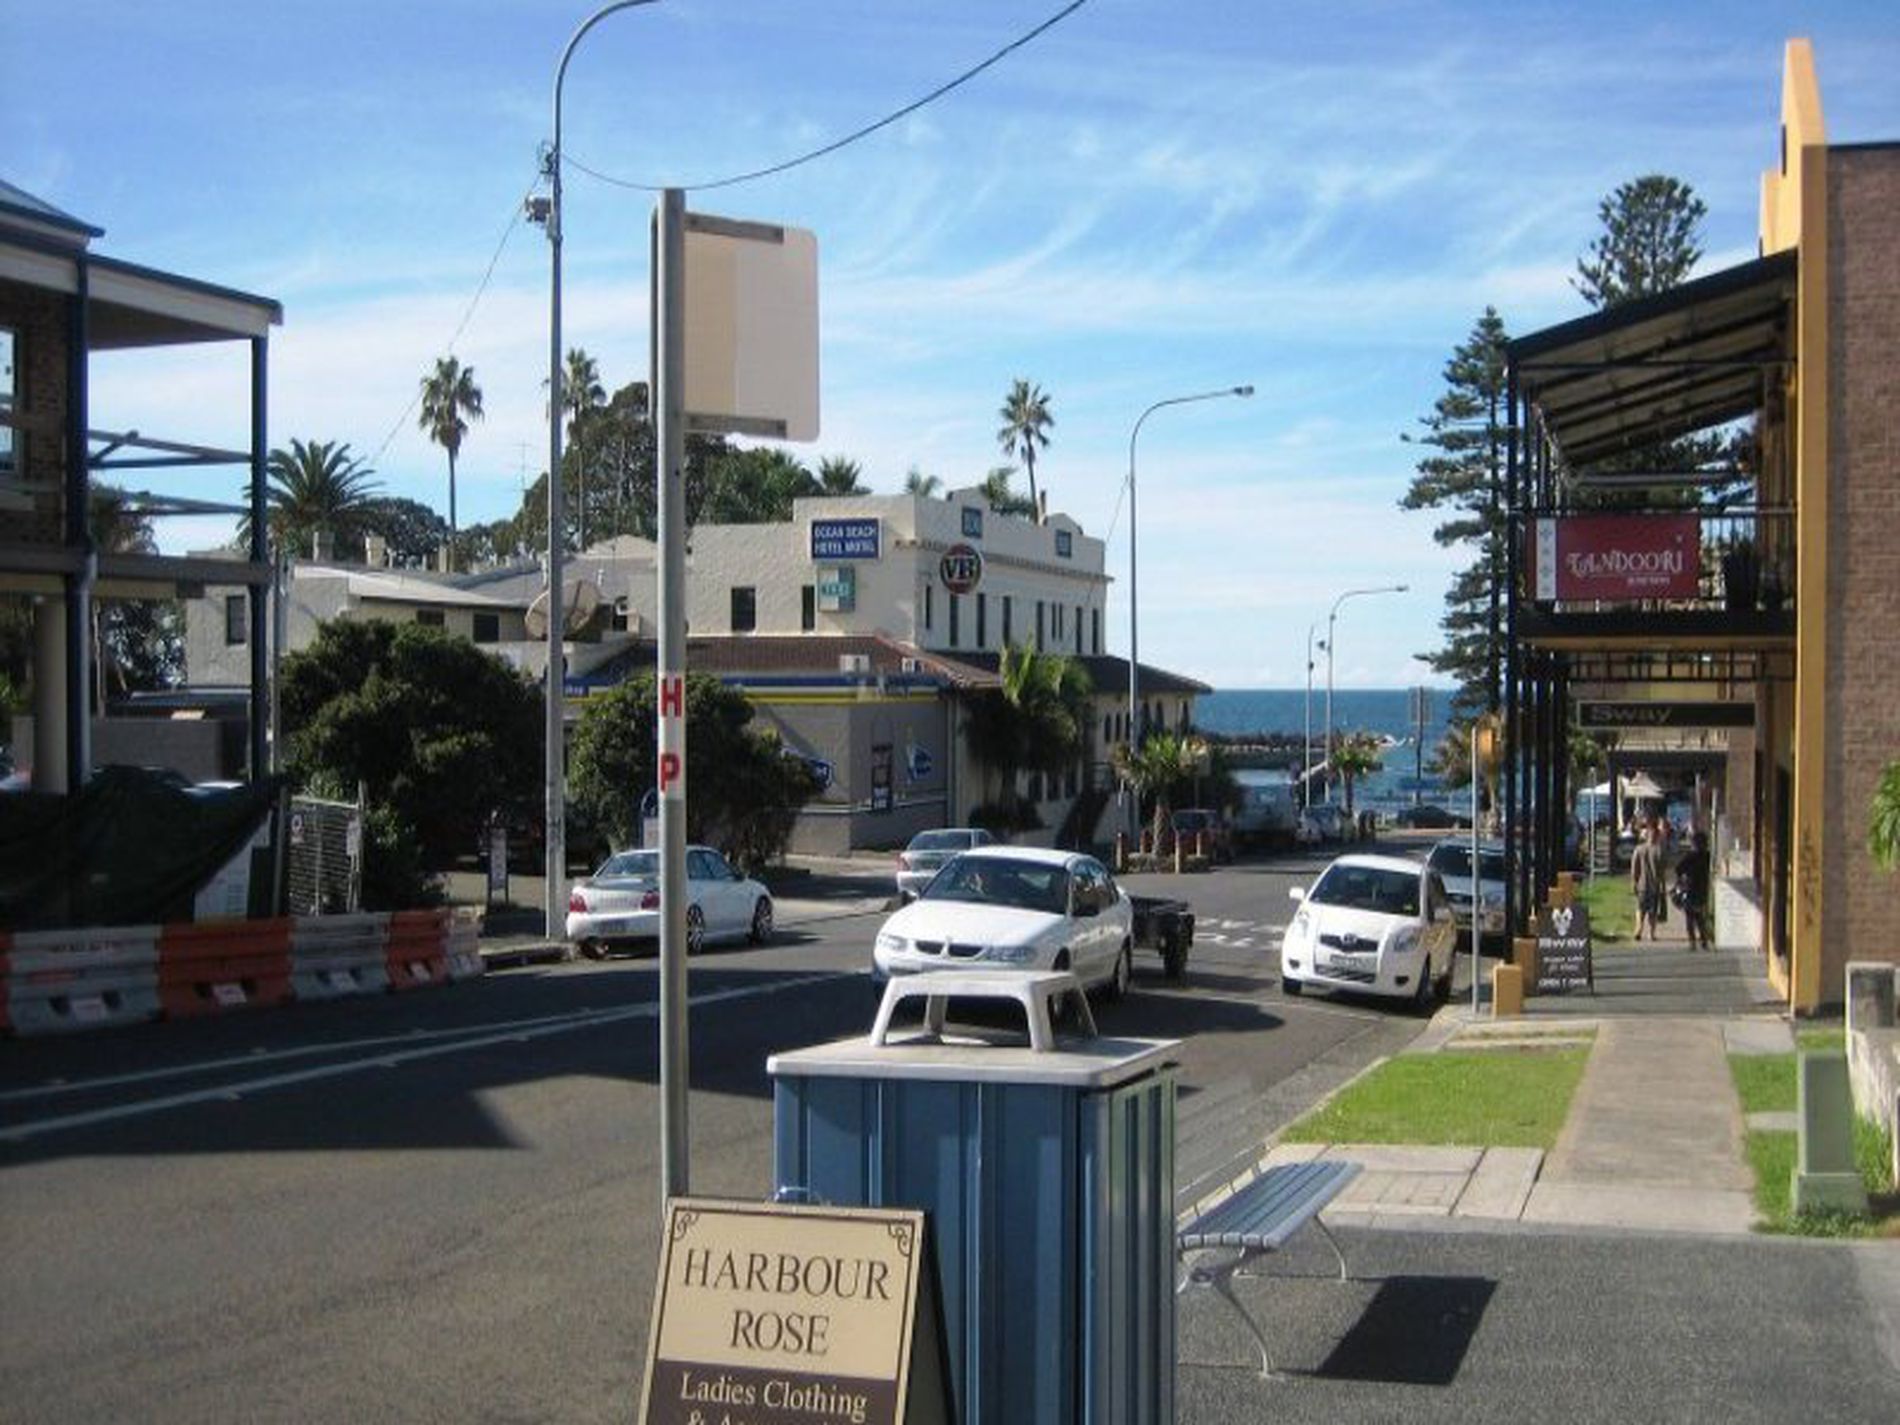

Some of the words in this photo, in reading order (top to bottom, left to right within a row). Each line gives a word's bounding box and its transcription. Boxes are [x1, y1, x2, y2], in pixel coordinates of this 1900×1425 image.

[815, 526, 844, 538] OCEAN
[846, 525, 876, 537] BEACH
[1566, 549, 1682, 577] TANDOORI
[661, 677, 682, 717] H
[660, 754, 680, 791] P
[684, 1248, 890, 1300] HARBOUR
[731, 1309, 830, 1356] ROSE
[680, 1371, 756, 1405] Ladies
[763, 1380, 868, 1423] Clothing
